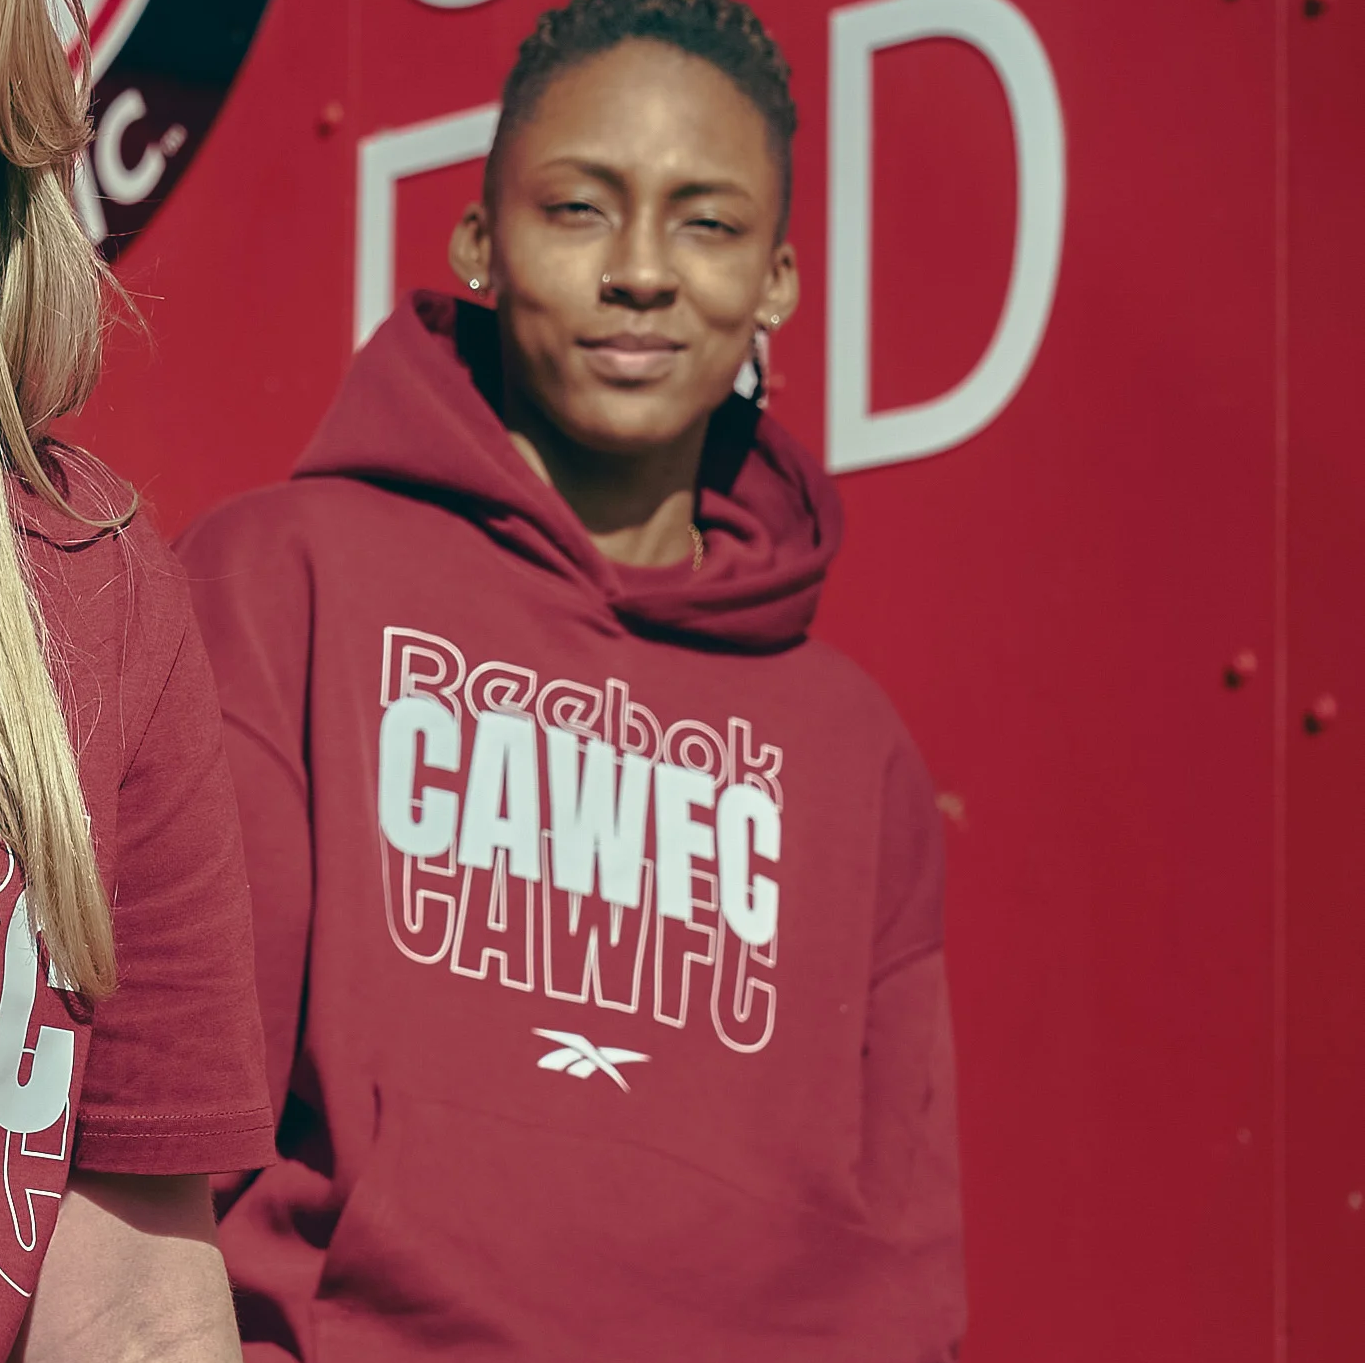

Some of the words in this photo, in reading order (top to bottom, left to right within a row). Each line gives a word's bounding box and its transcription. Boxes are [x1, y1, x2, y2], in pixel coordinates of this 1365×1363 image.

[379, 696, 782, 945] CAWFC
[380, 626, 783, 813] Reebok
[380, 828, 777, 1053] CAWFC
